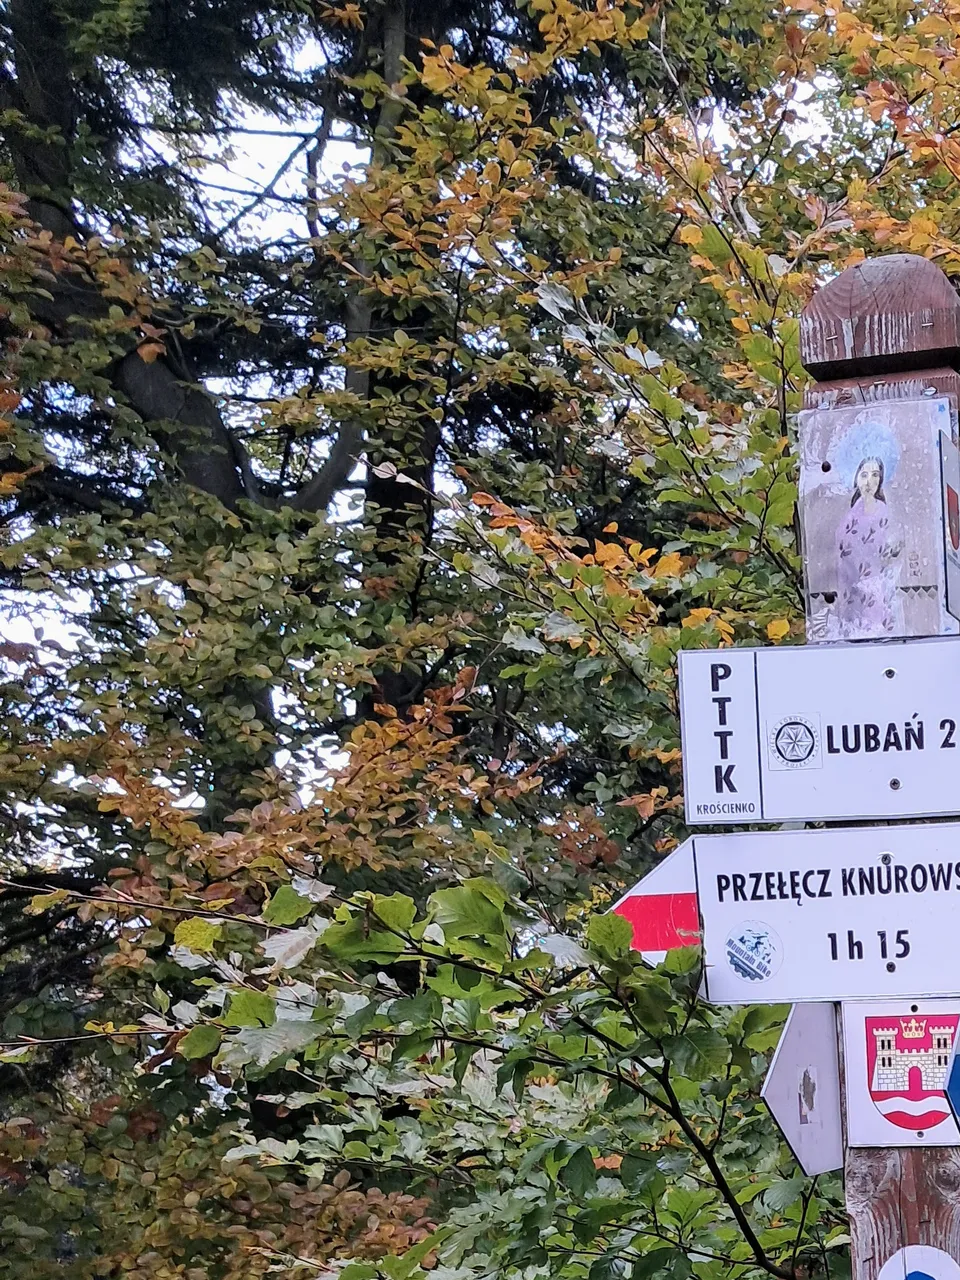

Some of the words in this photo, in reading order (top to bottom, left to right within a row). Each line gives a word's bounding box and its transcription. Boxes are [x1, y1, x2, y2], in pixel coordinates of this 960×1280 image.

[710, 663, 739, 794] PTTK
[826, 712, 925, 754] LUBAŃ
[696, 801, 756, 816] KROŚCIENKO
[716, 867, 832, 906] PRZEŁĘCZ
[876, 929, 911, 960] 15
